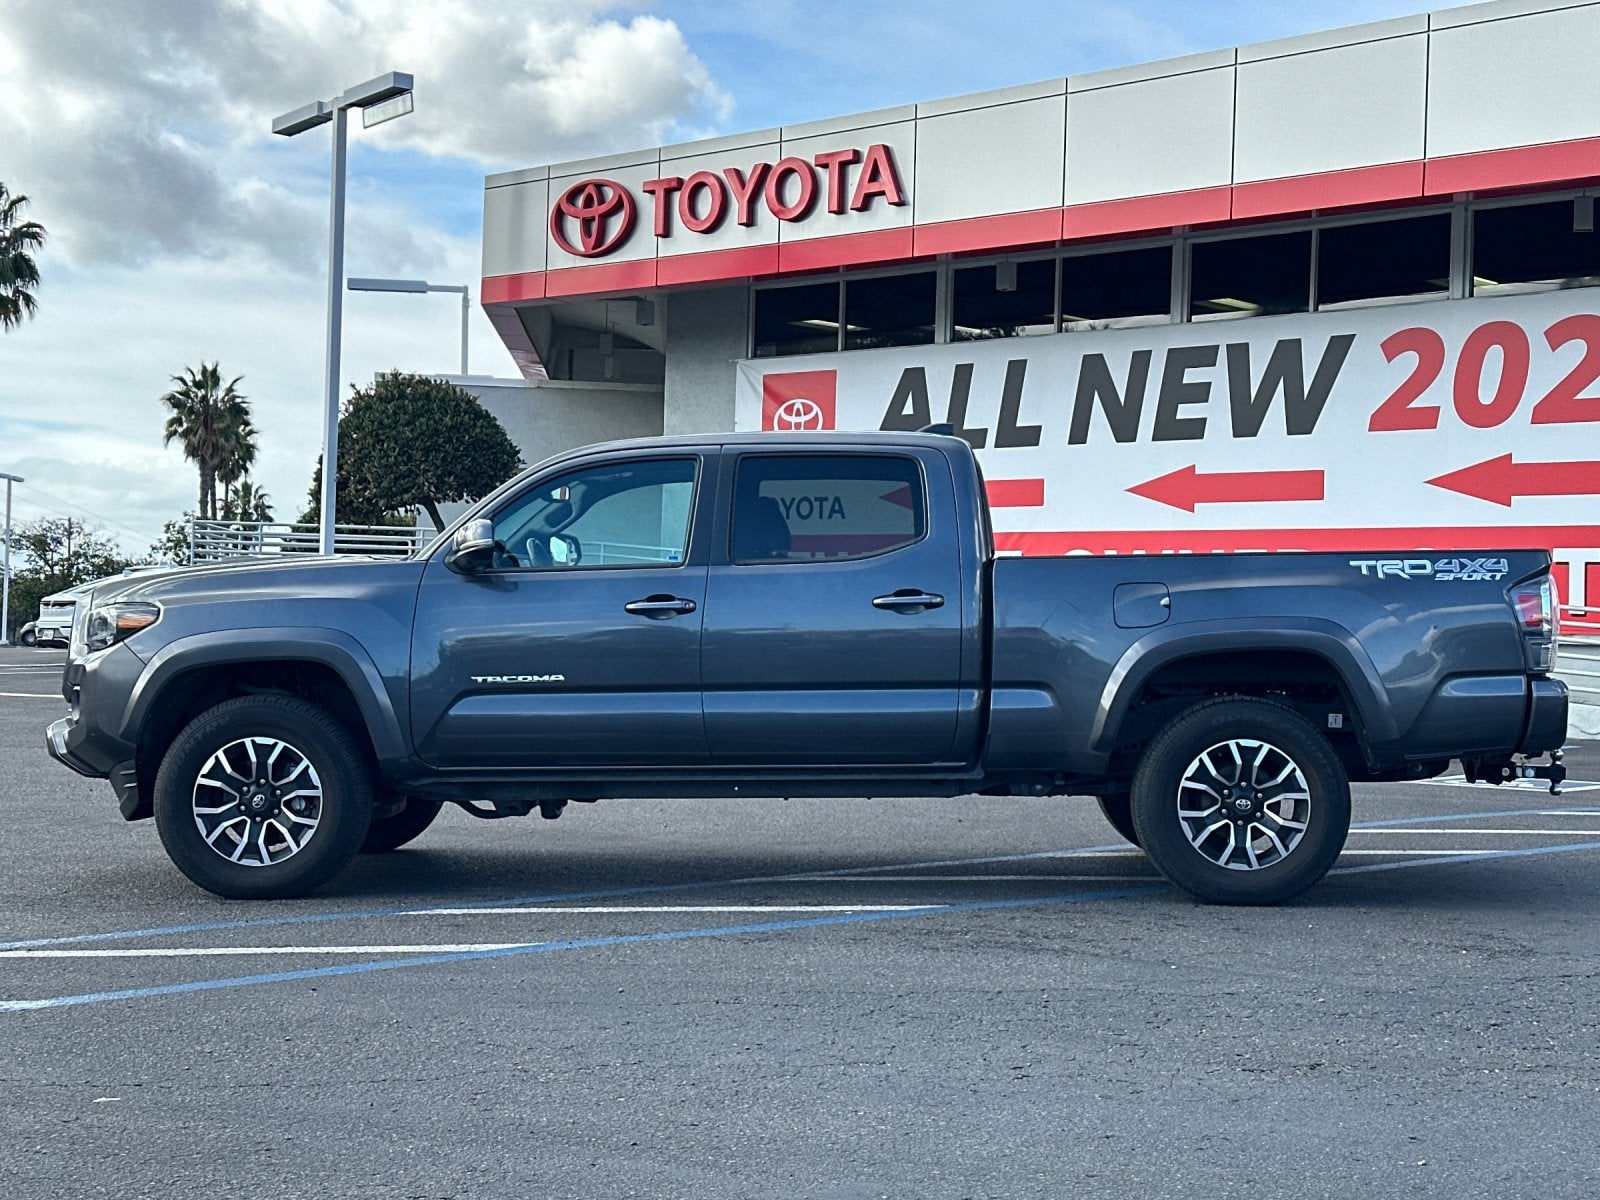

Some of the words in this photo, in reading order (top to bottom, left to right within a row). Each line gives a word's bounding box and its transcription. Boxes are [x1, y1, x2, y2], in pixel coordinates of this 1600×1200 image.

[643, 144, 905, 238] TOYOTA
[879, 359, 1042, 449] ALL
[1068, 334, 1356, 445] NEW
[1368, 314, 1600, 432] 202
[780, 496, 846, 520] YOTA
[1350, 559, 1435, 580] TRD
[1435, 572, 1507, 581] SPORT
[471, 674, 565, 683] TACOMA
